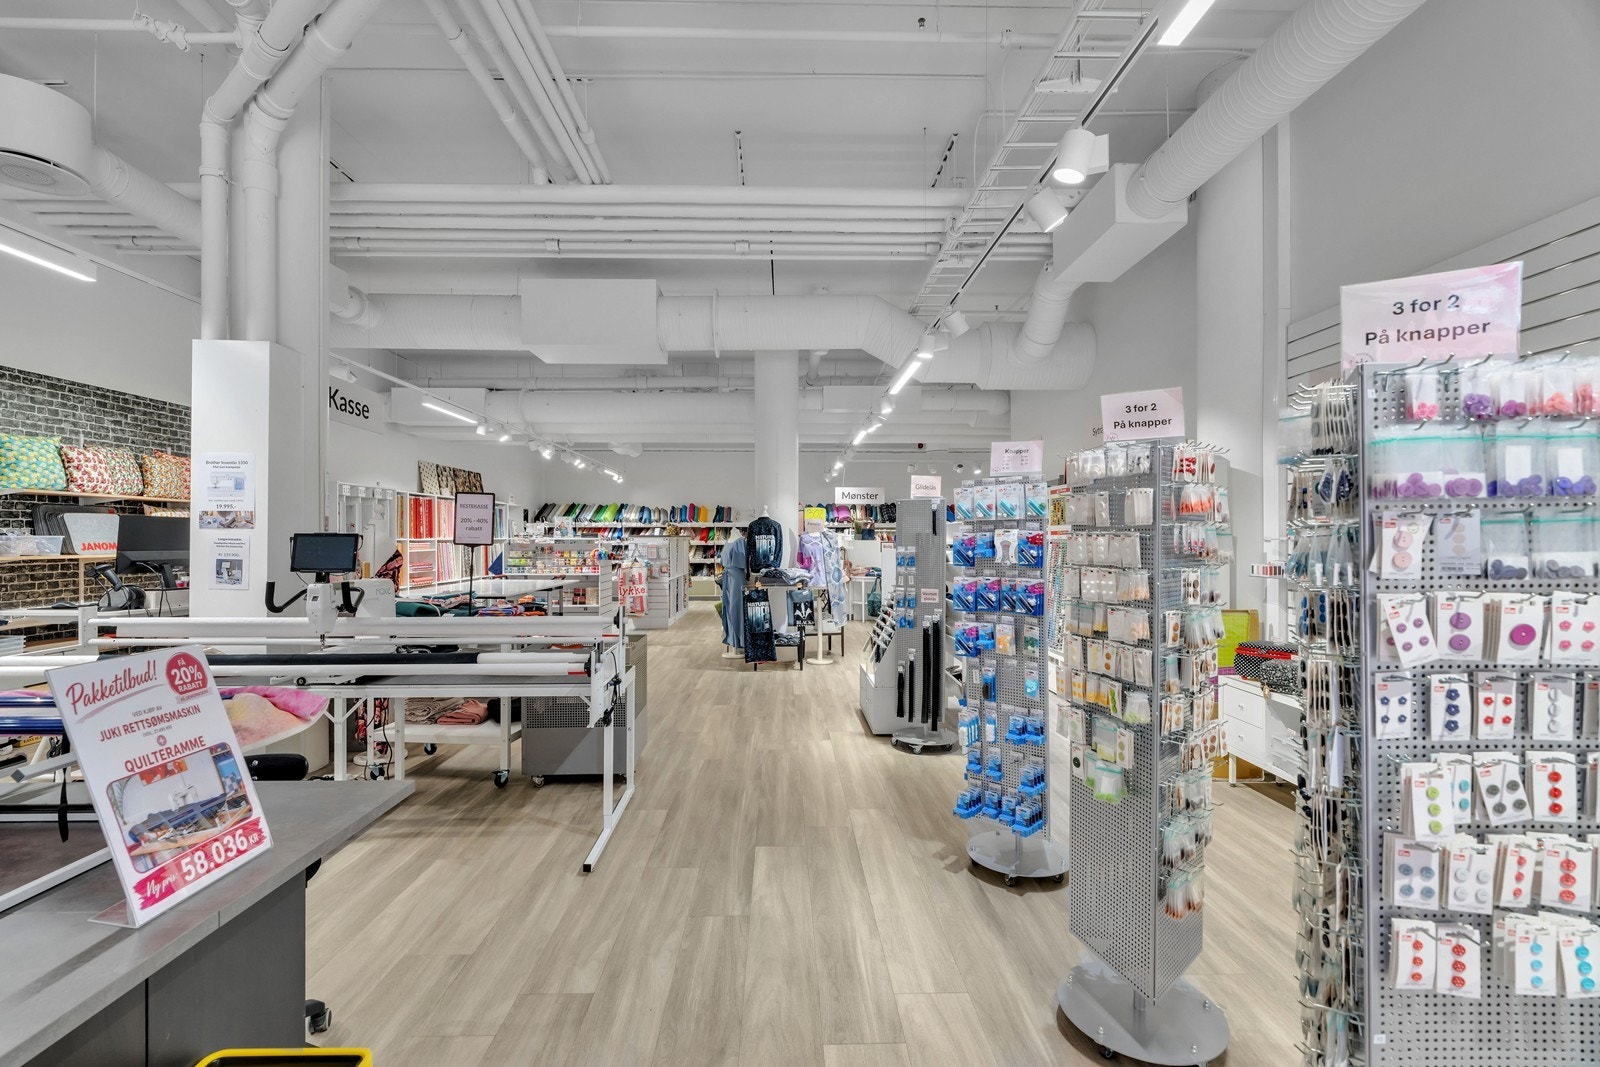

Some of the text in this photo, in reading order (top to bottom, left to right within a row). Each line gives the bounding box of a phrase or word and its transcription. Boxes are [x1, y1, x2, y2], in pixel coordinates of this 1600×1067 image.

[1392, 294, 1460, 315] 3 for 2
[1365, 321, 1491, 346] På knapper
[329, 386, 370, 419] Kasse
[1125, 403, 1157, 413] 3 for 2
[1114, 418, 1172, 429] På knapper
[841, 491, 879, 500] Mønster
[81, 542, 117, 551] JANOM
[619, 586, 646, 597] lykke
[177, 657, 186, 666] FÅ
[171, 665, 203, 686] 20%
[66, 660, 158, 716] Pakketilbud!
[178, 681, 203, 693] RABATT
[132, 710, 143, 718] VED
[100, 726, 122, 742] JUKI
[122, 704, 201, 735] RETTSØMSMASKIN
[124, 735, 206, 774] QUILTERAMME
[146, 879, 161, 899] Ny
[180, 829, 248, 881] 58.036
[248, 833, 260, 845] KR
